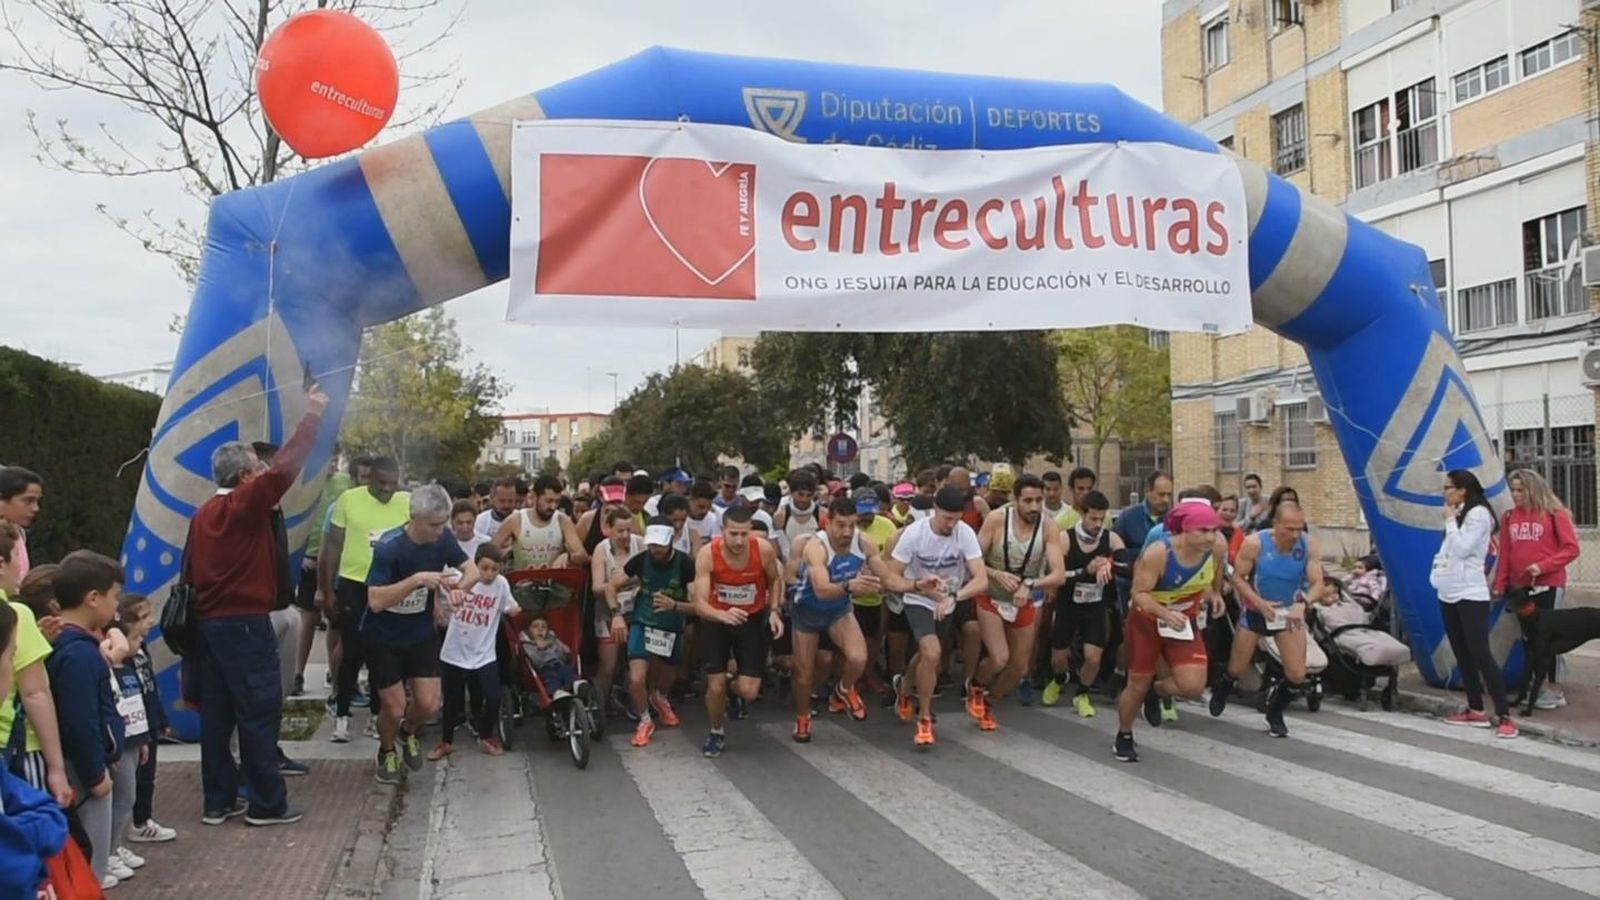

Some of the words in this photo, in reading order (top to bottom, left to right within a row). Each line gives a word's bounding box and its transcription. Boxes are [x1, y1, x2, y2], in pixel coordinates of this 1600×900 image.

[310, 80, 385, 119] entreculturas
[821, 91, 962, 124] Diputación
[987, 107, 1101, 133] DEPORTES
[781, 174, 1229, 256] entreculturas
[785, 275, 828, 290] ONG
[835, 275, 907, 291] JESUITA
[914, 275, 956, 291] PARA
[962, 276, 981, 291] LA
[986, 271, 1091, 291] EDUCACIÓN
[1097, 272, 1108, 285] Y
[1115, 271, 1133, 286] EL
[1136, 274, 1231, 295] DESARROLLO
[460, 594, 497, 610] ORRE
